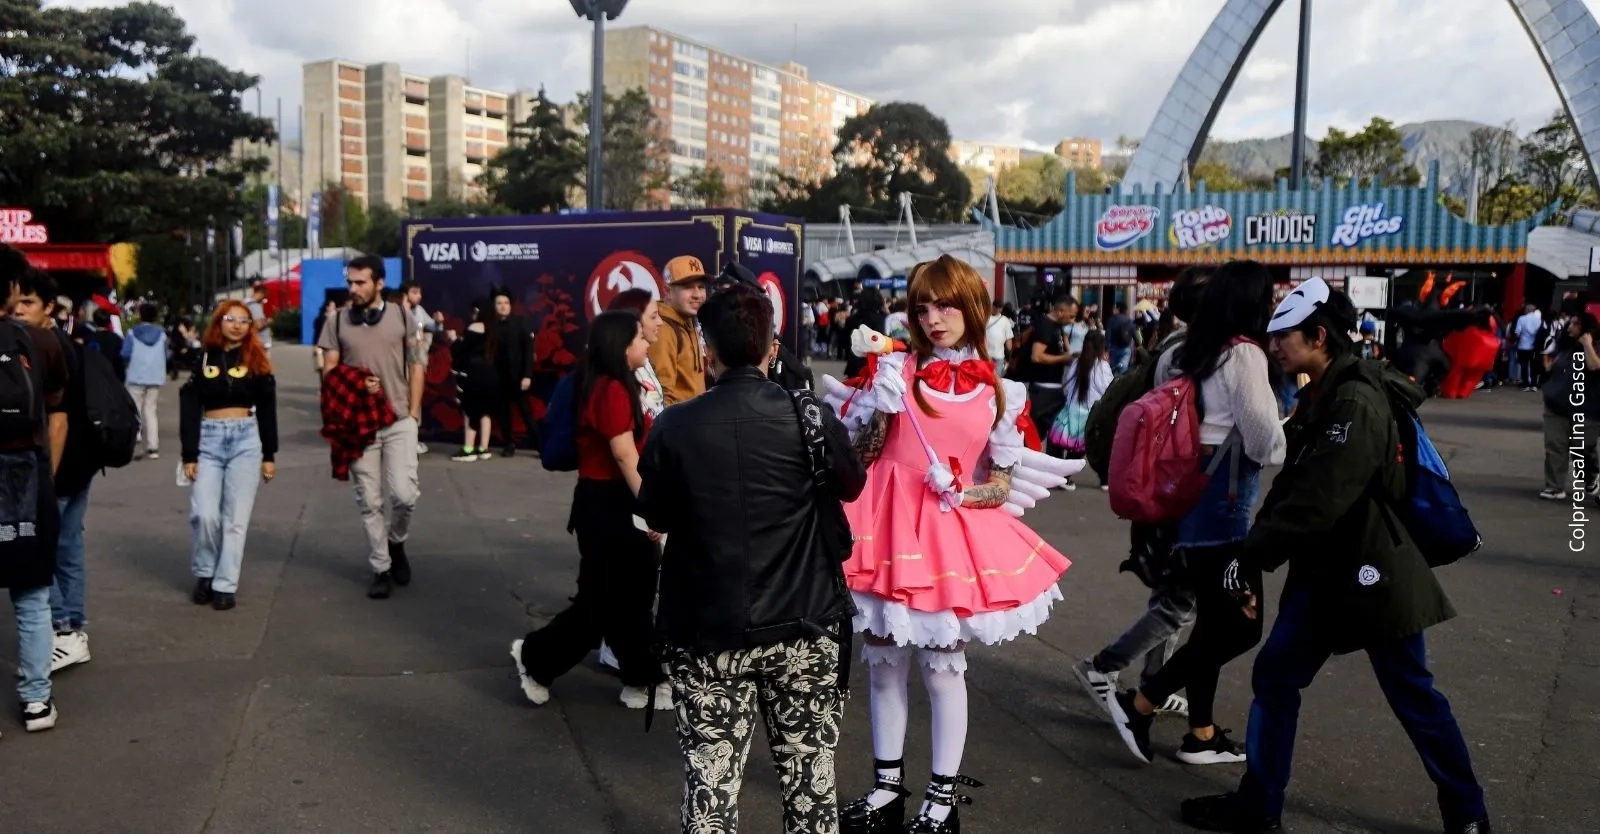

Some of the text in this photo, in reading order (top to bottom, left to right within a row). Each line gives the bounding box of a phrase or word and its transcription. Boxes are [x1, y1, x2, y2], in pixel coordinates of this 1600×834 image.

[1172, 205, 1227, 229] Todo
[1245, 214, 1316, 244] CHIDOS
[743, 235, 763, 252] VISA
[1175, 223, 1230, 249] Rico
[418, 242, 461, 262] VISA
